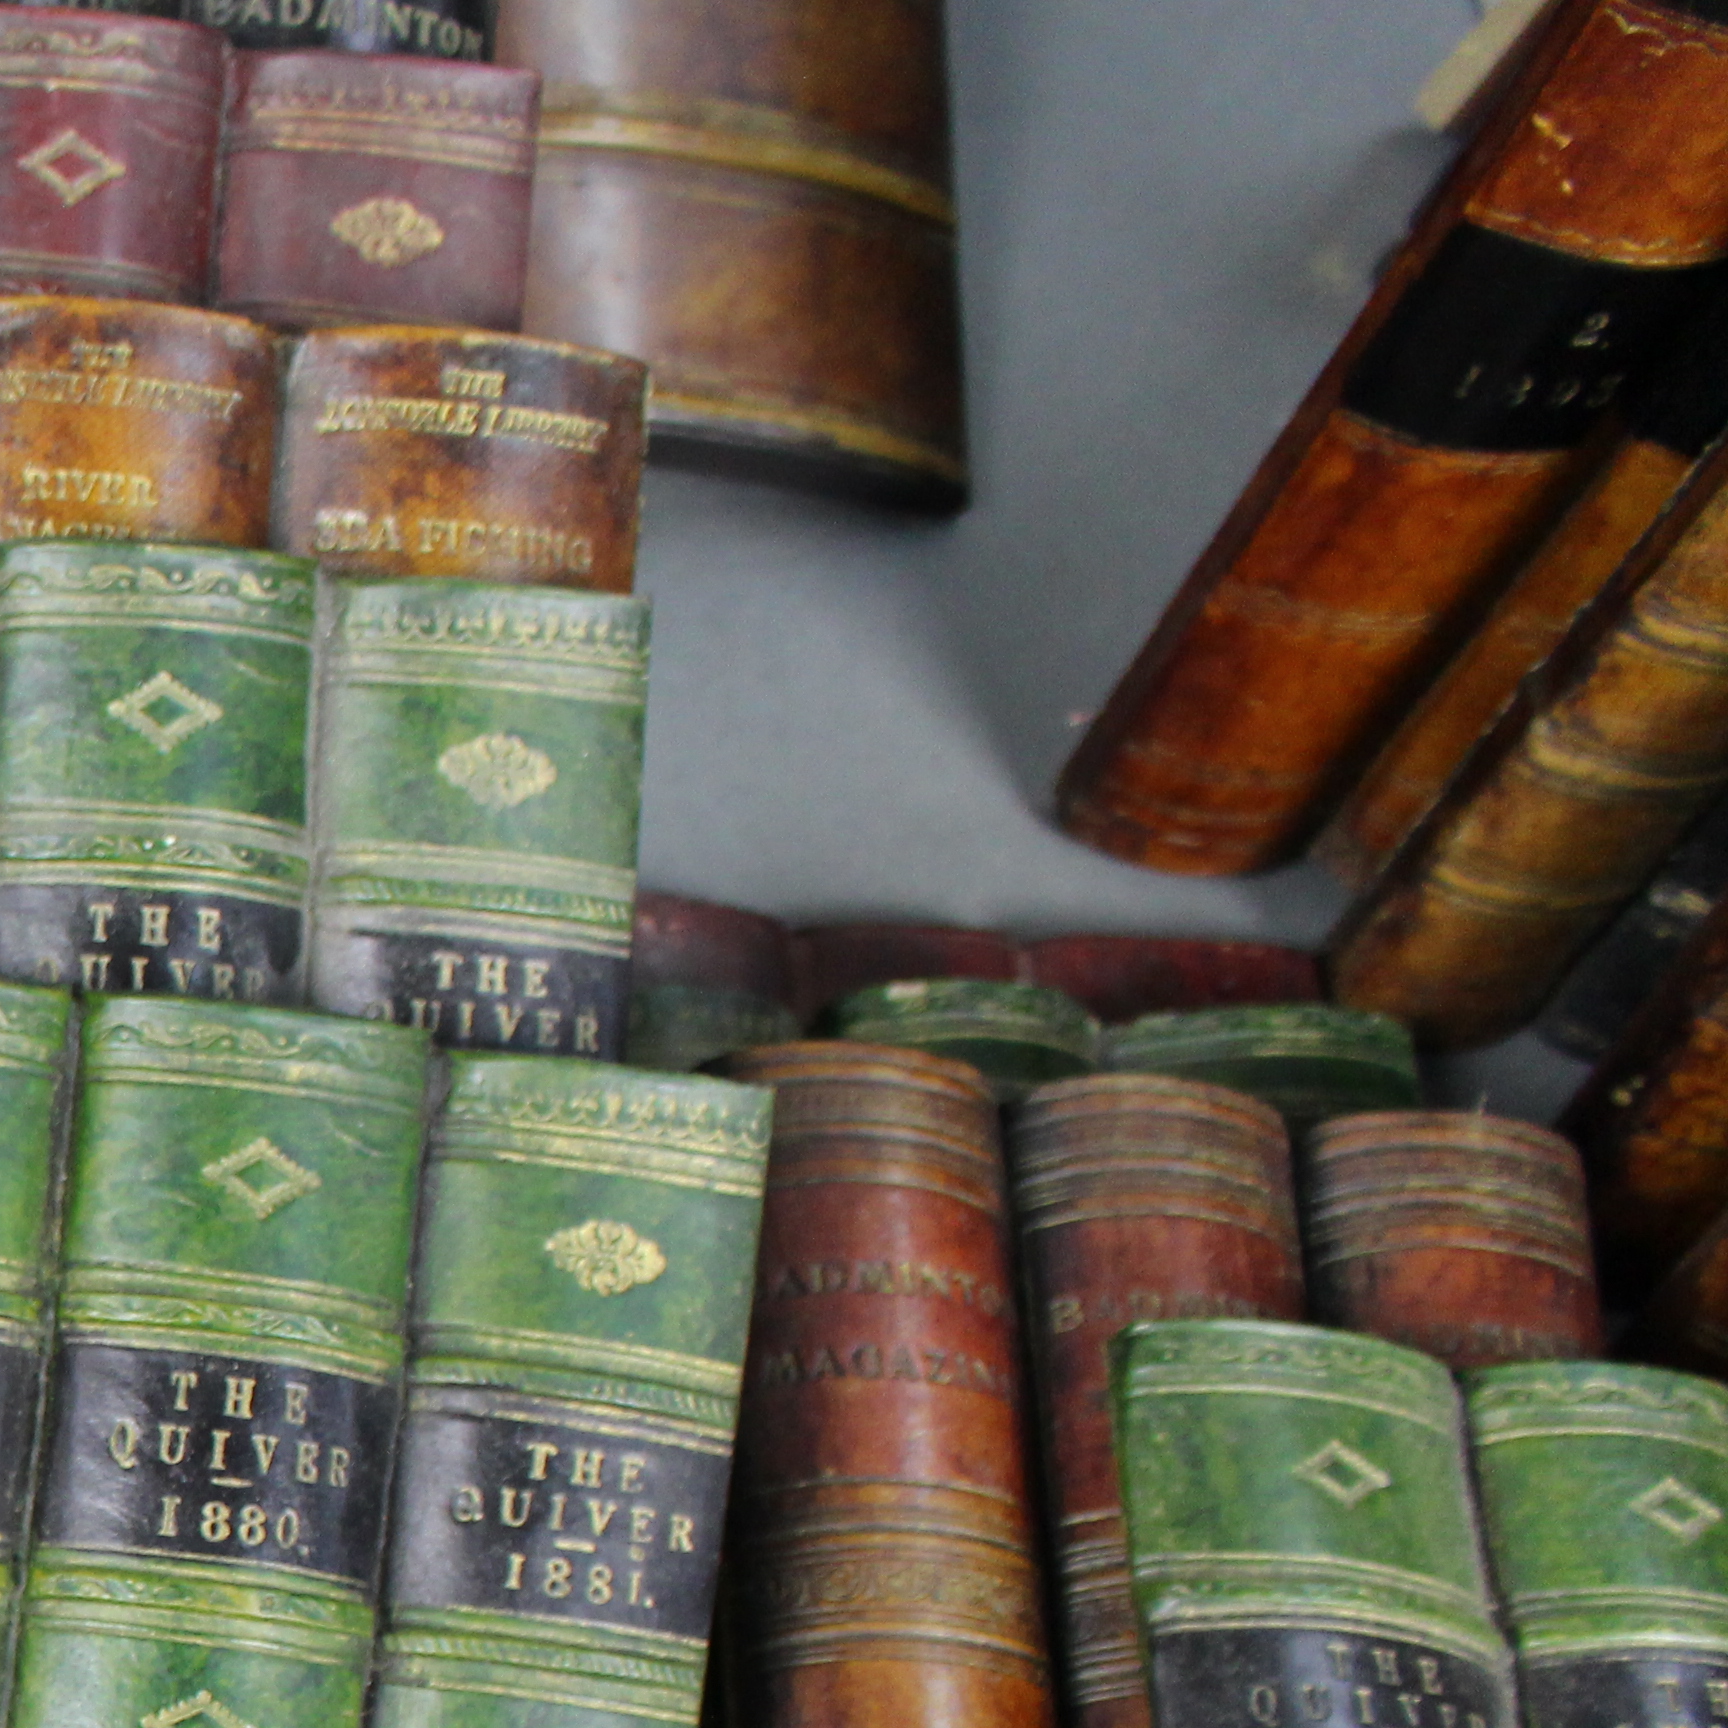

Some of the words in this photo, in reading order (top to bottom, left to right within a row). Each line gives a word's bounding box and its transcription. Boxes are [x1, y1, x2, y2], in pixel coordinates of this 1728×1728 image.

[86, 901, 224, 956] THE
[431, 949, 552, 1000] THE
[169, 1369, 311, 1427] THE
[108, 1416, 352, 1489] QUIVER
[526, 1440, 648, 1494] THE
[157, 1494, 312, 1558] 1880.
[450, 1483, 696, 1553] QUIVER
[504, 1550, 657, 1610] 1881.
[1326, 1640, 1444, 1696] THE
[1656, 1677, 1728, 1718] TH
